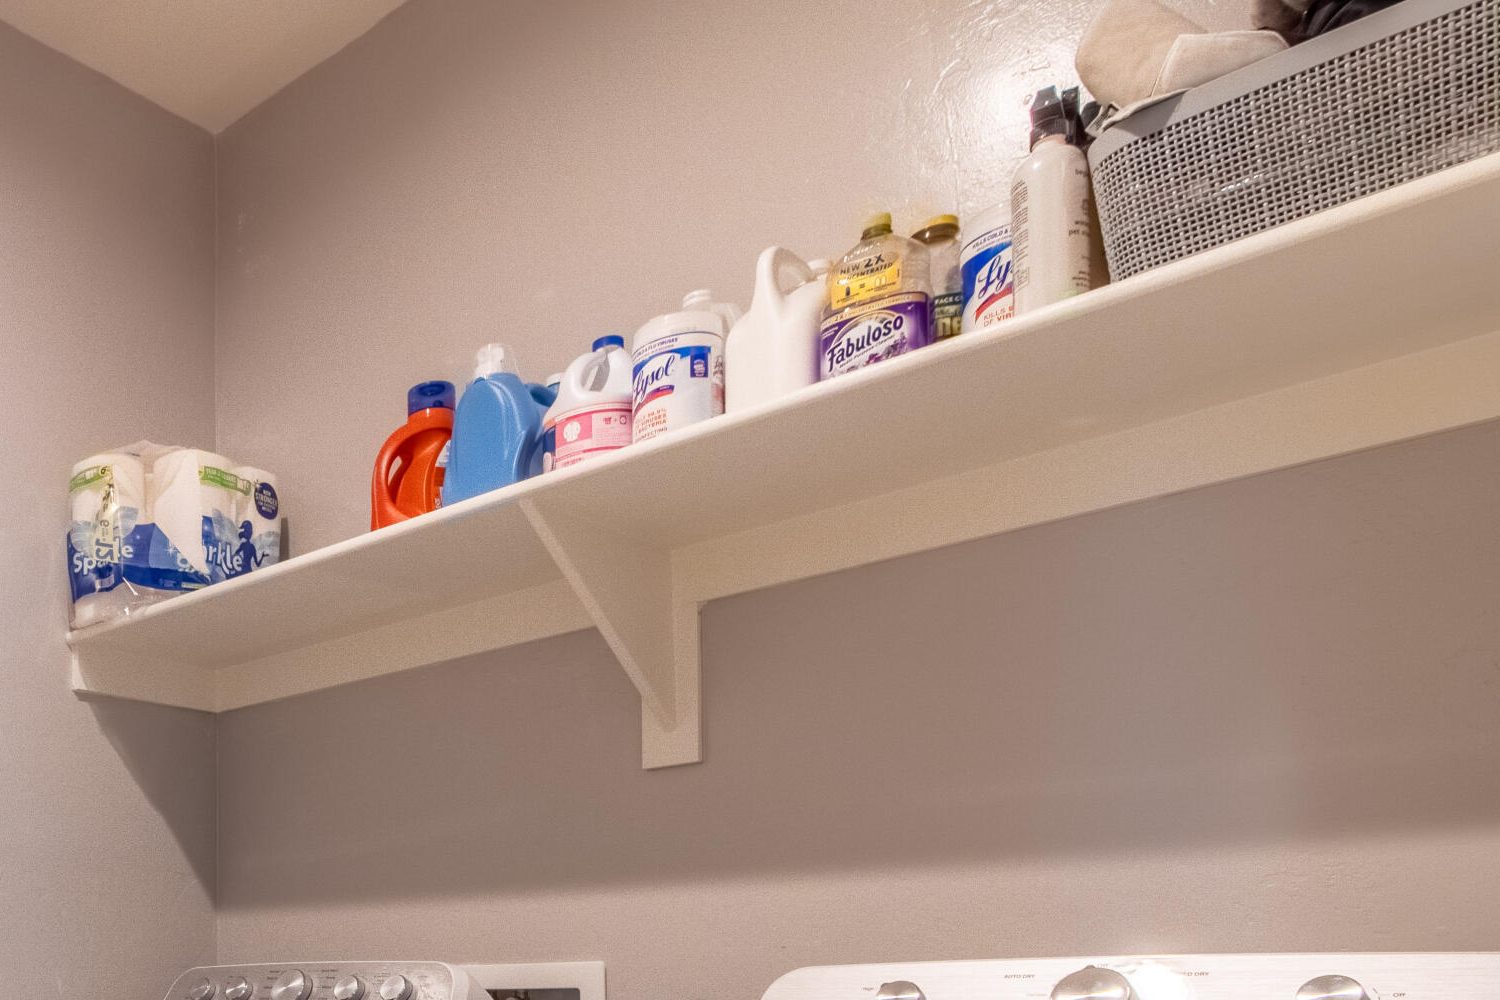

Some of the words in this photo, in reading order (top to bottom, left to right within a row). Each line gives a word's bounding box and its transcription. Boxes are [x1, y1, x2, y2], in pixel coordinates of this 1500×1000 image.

[864, 254, 885, 269] 2X
[977, 254, 1012, 300] Ly
[996, 312, 1012, 321] VIR
[826, 315, 904, 373] Fabuloso
[633, 354, 676, 402] Lysol
